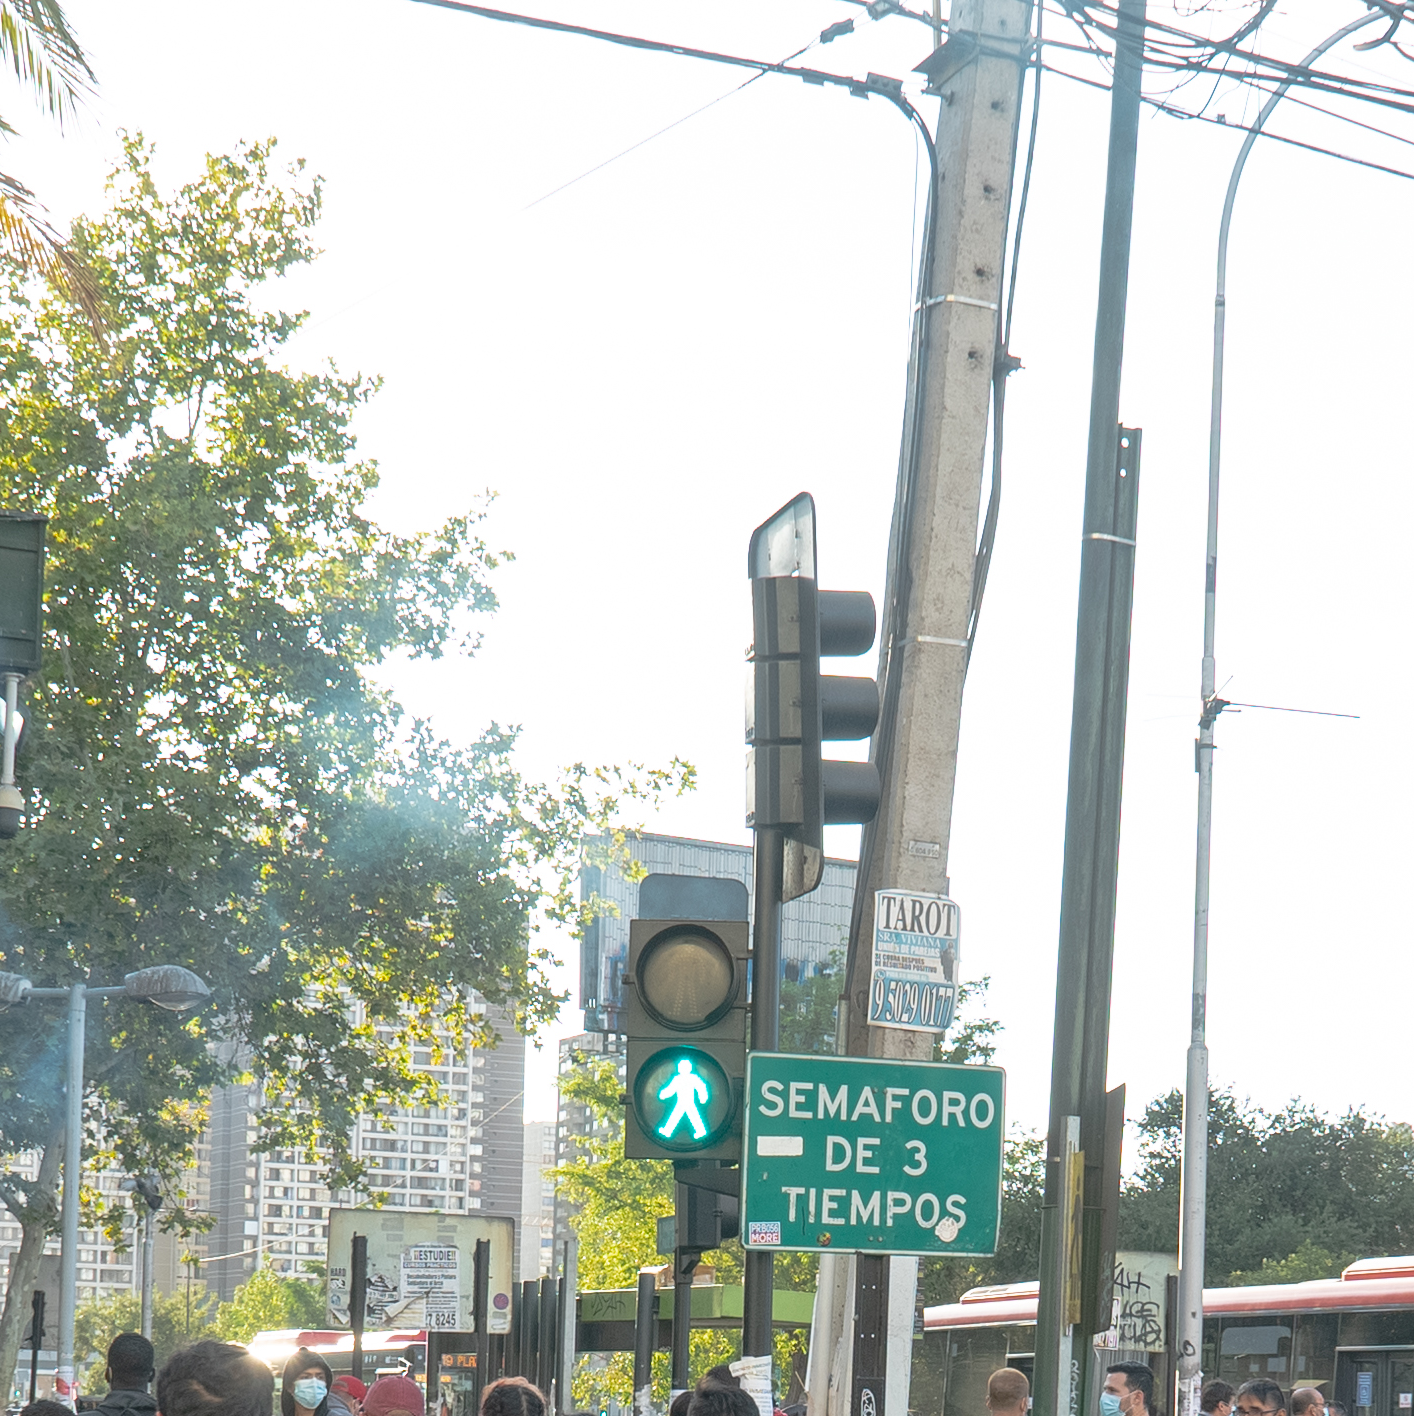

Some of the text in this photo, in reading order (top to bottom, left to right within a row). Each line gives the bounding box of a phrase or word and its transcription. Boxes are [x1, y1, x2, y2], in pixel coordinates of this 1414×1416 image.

[882, 895, 956, 937] TAROT
[900, 944, 909, 954] DE
[911, 945, 941, 958] PAREJAS
[901, 935, 941, 948] VIVIANA
[873, 980, 954, 1027] 9 5029 0177
[758, 1080, 995, 1129] SEMAFORO
[825, 1135, 928, 1176] DE 3
[782, 1186, 967, 1229] TIEMPOS
[751, 1233, 779, 1243] MORE
[435, 1313, 457, 1326] 8245
